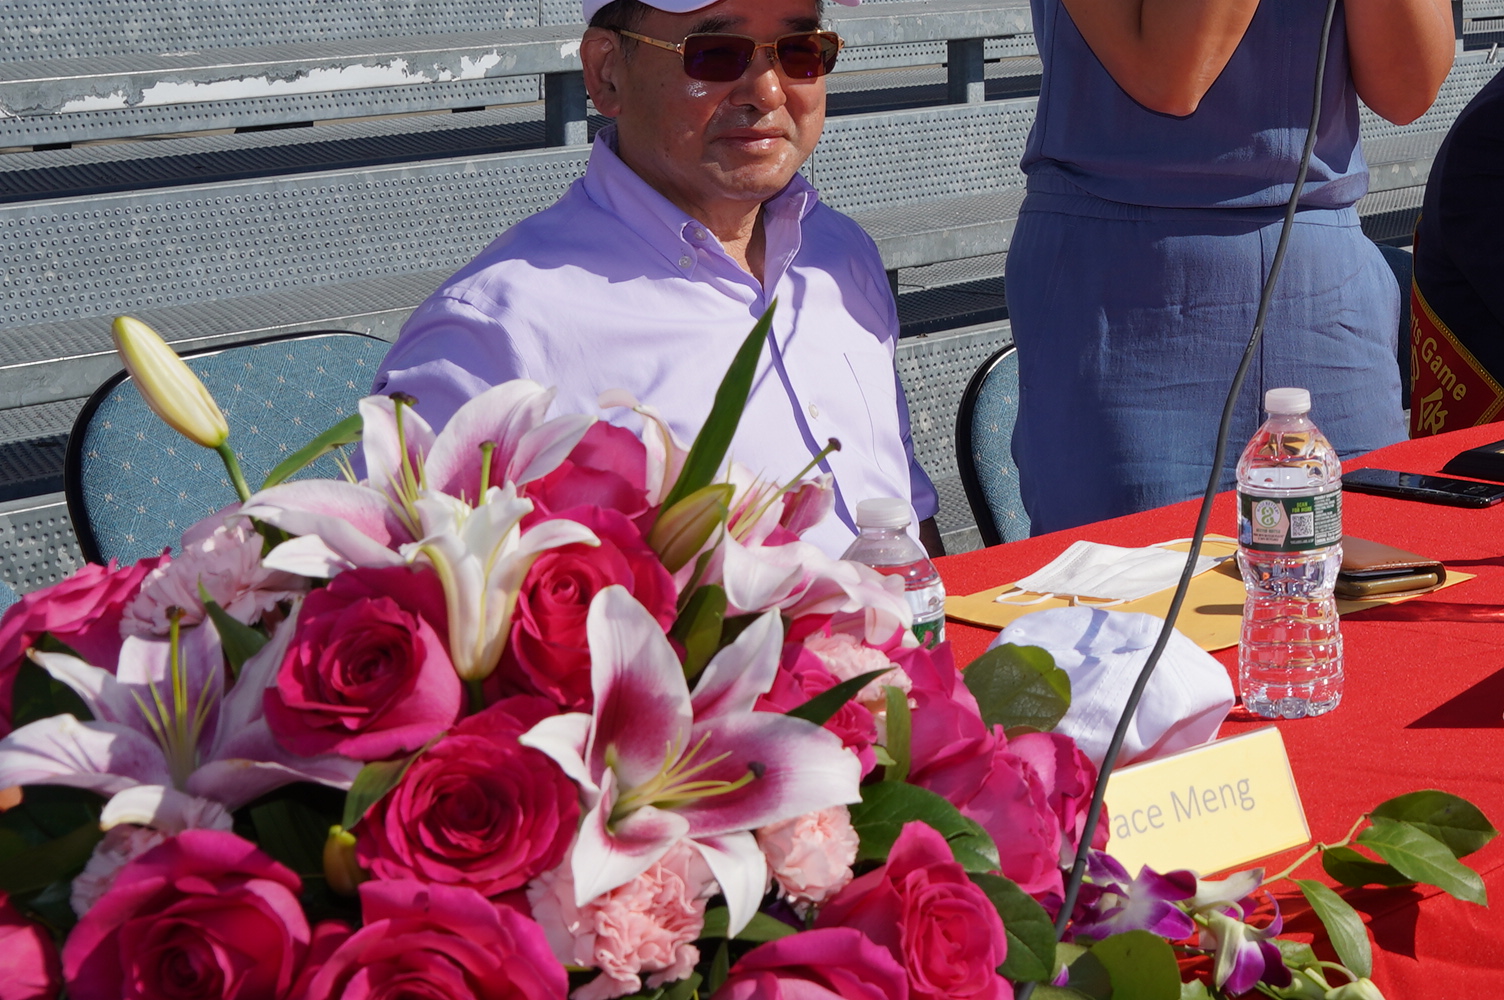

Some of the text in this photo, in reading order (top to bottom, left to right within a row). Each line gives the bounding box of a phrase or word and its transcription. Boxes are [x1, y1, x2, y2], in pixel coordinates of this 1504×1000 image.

[1421, 336, 1468, 402] Game
[1108, 776, 1256, 840] ace Meng
